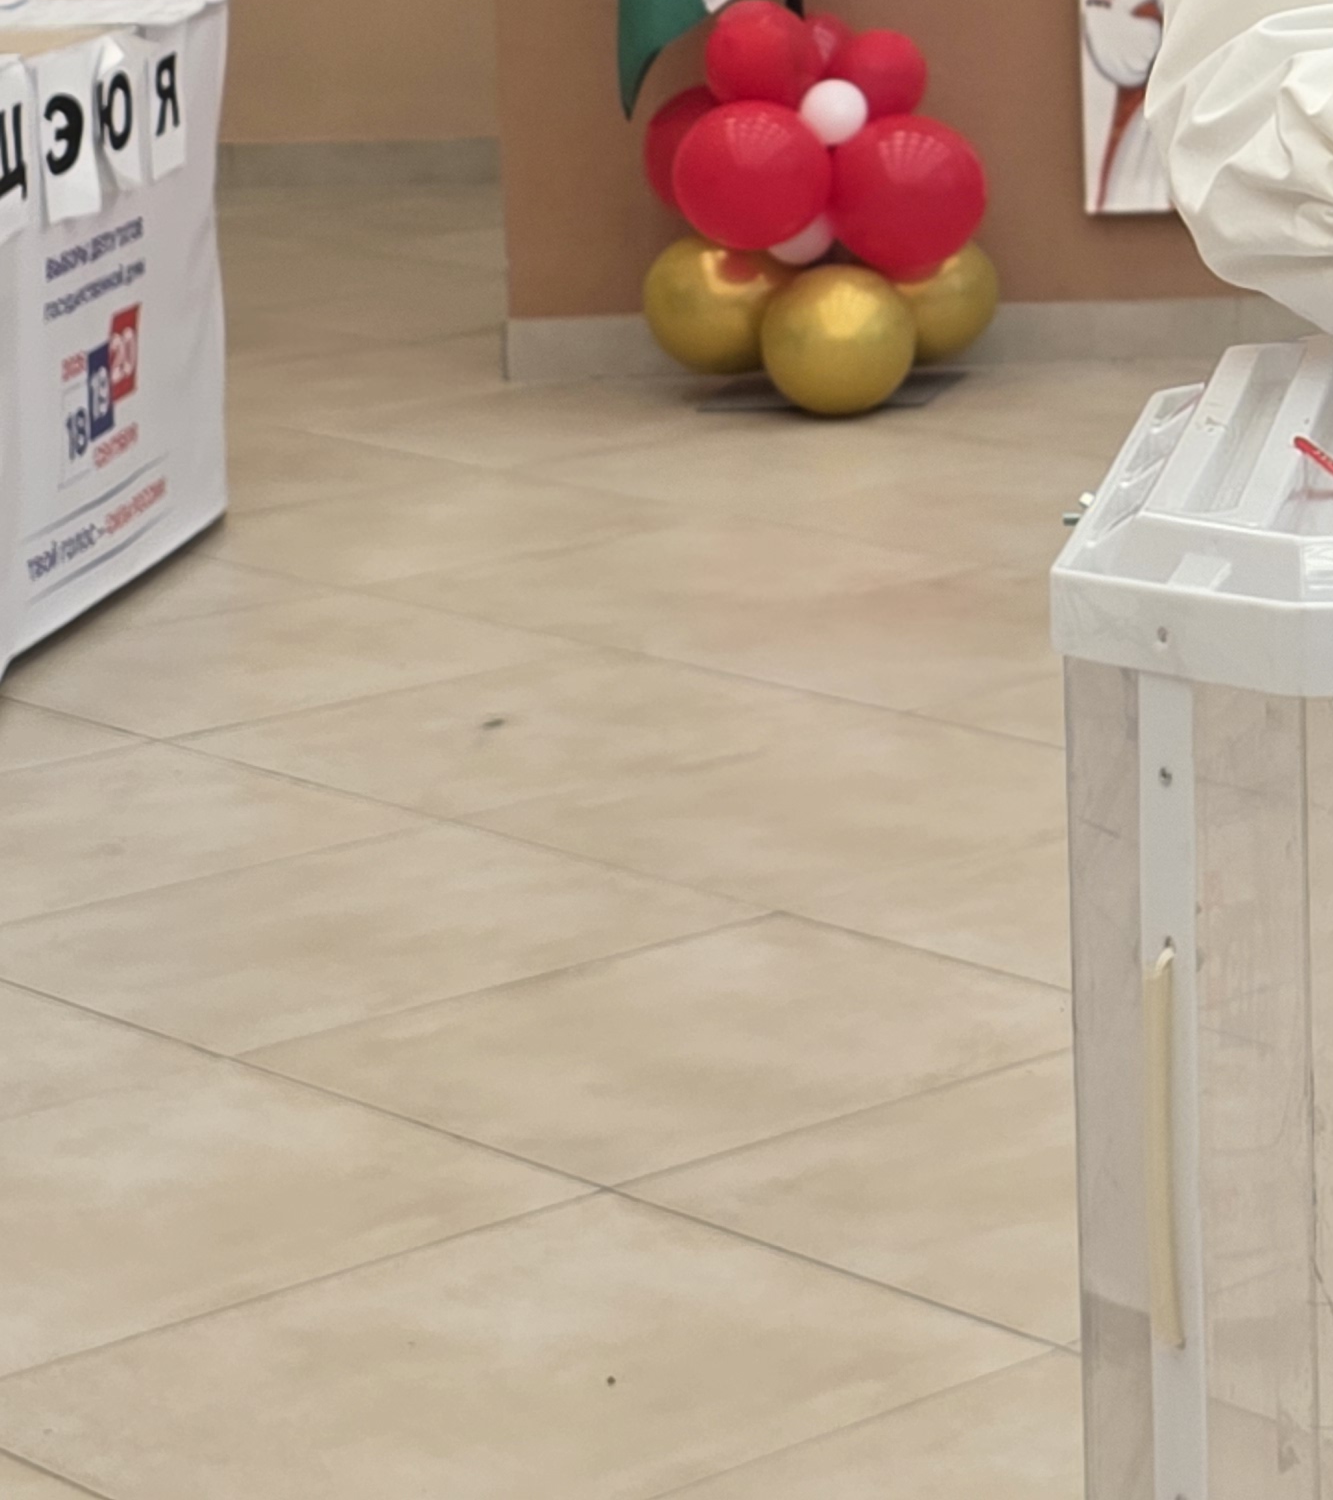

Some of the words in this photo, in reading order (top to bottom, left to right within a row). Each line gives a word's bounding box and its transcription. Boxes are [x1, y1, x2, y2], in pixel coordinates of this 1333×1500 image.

[44, 92, 83, 176] Э
[96, 69, 133, 151] Ю
[155, 51, 180, 136] Я
[108, 325, 136, 383] 20
[90, 365, 110, 420] 19
[66, 406, 88, 461] 18
